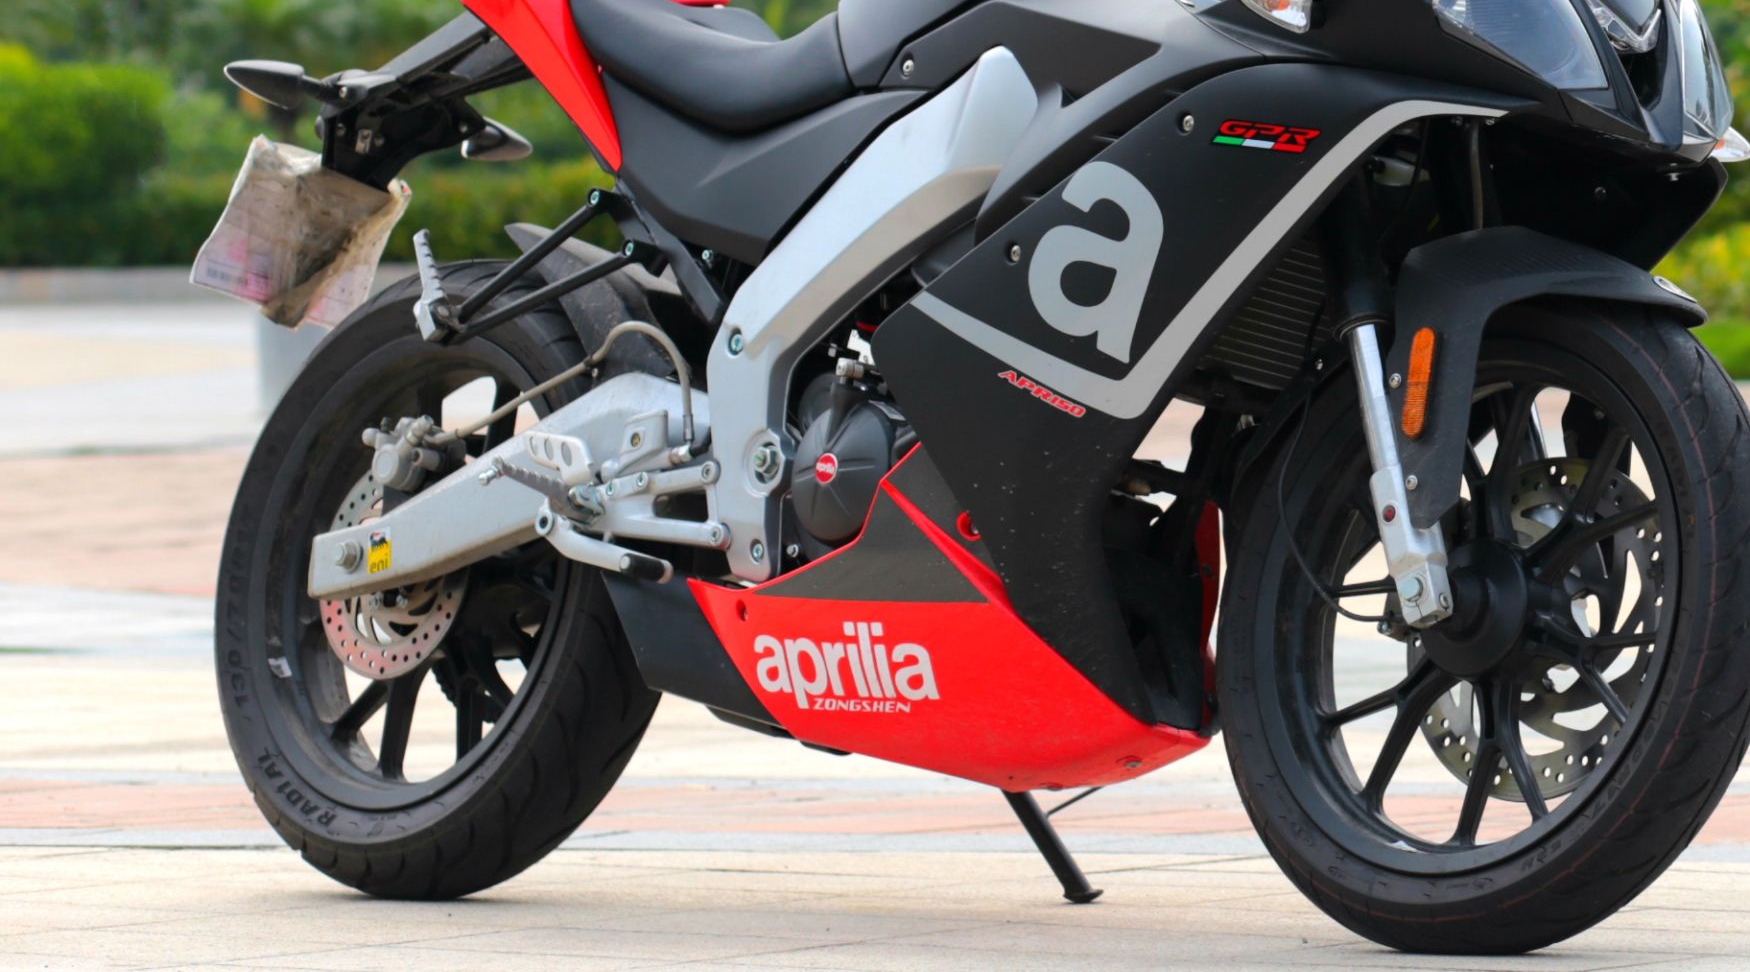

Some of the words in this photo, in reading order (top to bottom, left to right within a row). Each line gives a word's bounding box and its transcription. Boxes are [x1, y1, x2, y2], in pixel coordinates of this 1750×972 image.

[1219, 120, 1321, 144] GPR
[1028, 161, 1164, 364] a
[998, 370, 1086, 418] APR150
[370, 553, 389, 574] eni
[754, 622, 941, 709] aprilia
[813, 698, 911, 713] ZONGSHEN
[257, 747, 337, 827] RADIAL
